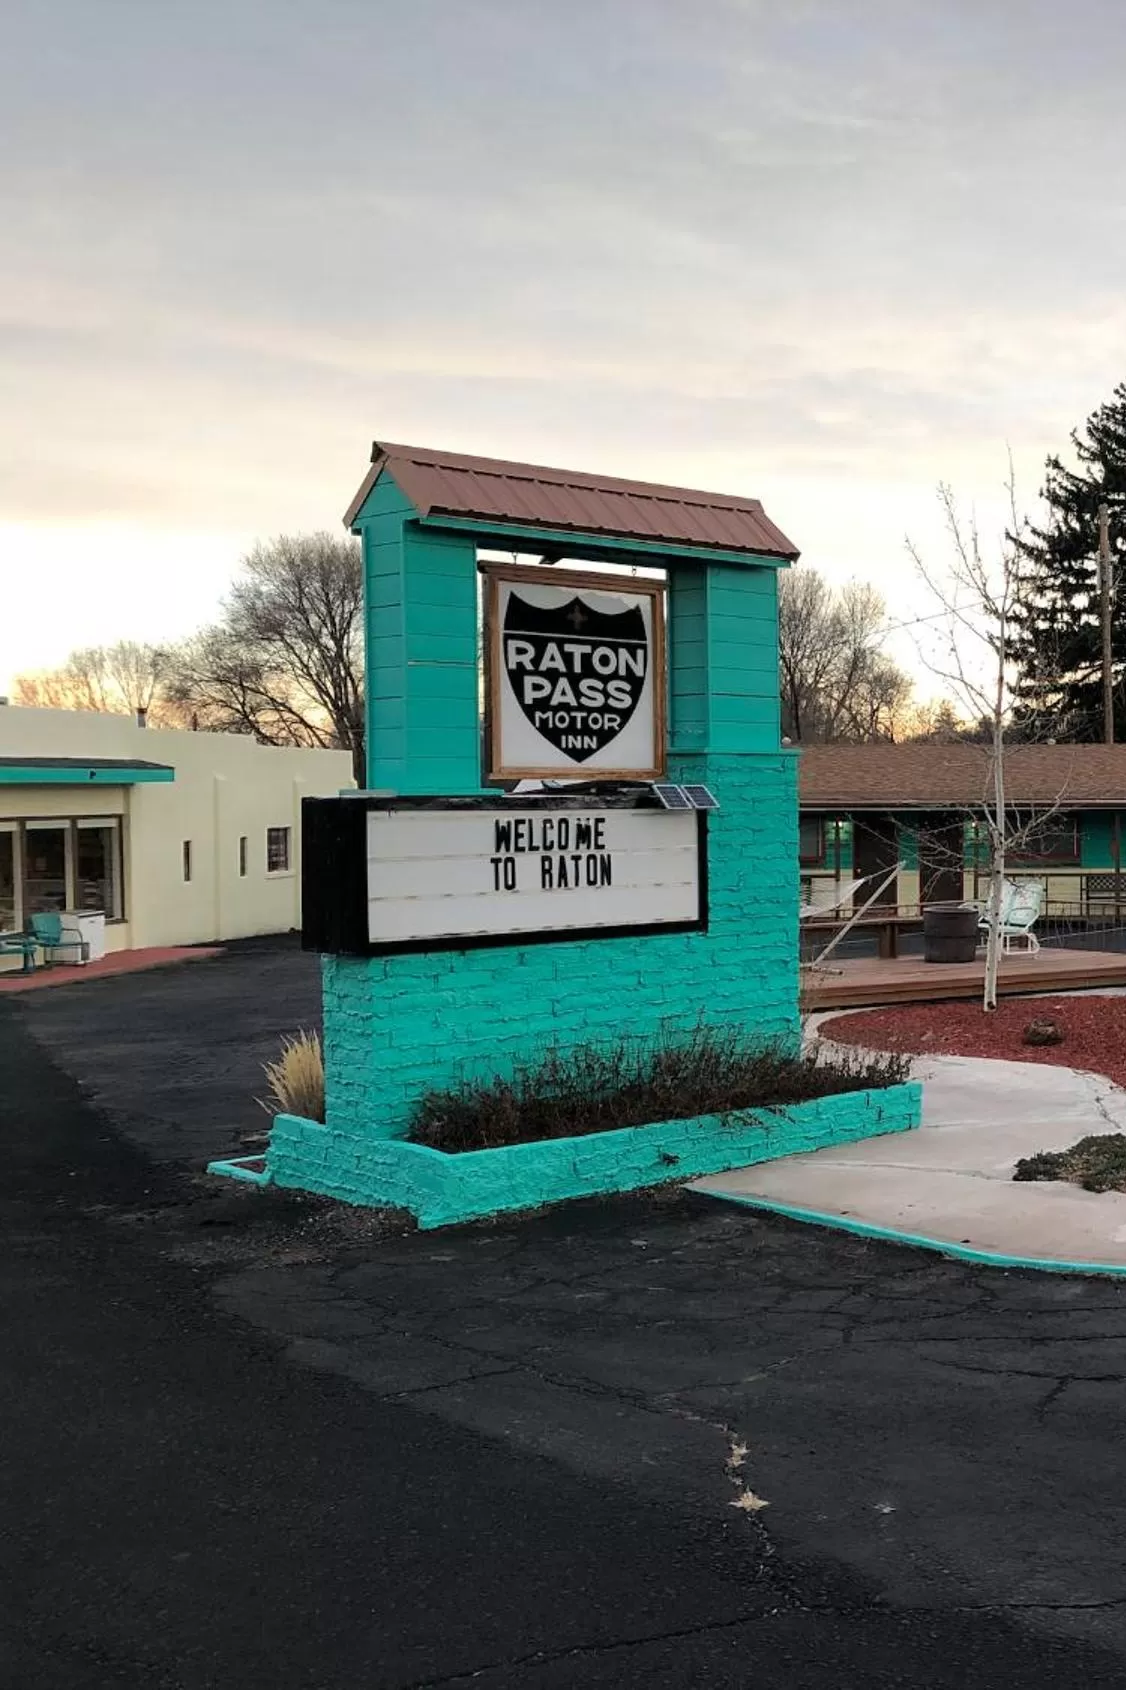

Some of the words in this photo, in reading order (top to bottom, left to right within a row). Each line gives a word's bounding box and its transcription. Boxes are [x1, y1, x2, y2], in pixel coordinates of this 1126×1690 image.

[507, 639, 645, 677] RATON
[523, 675, 633, 709] PASS
[535, 711, 621, 730] MOTOR
[561, 735, 598, 749] INN
[494, 817, 606, 853] WELCOME
[490, 856, 516, 891] TO
[541, 853, 612, 889] RATON
